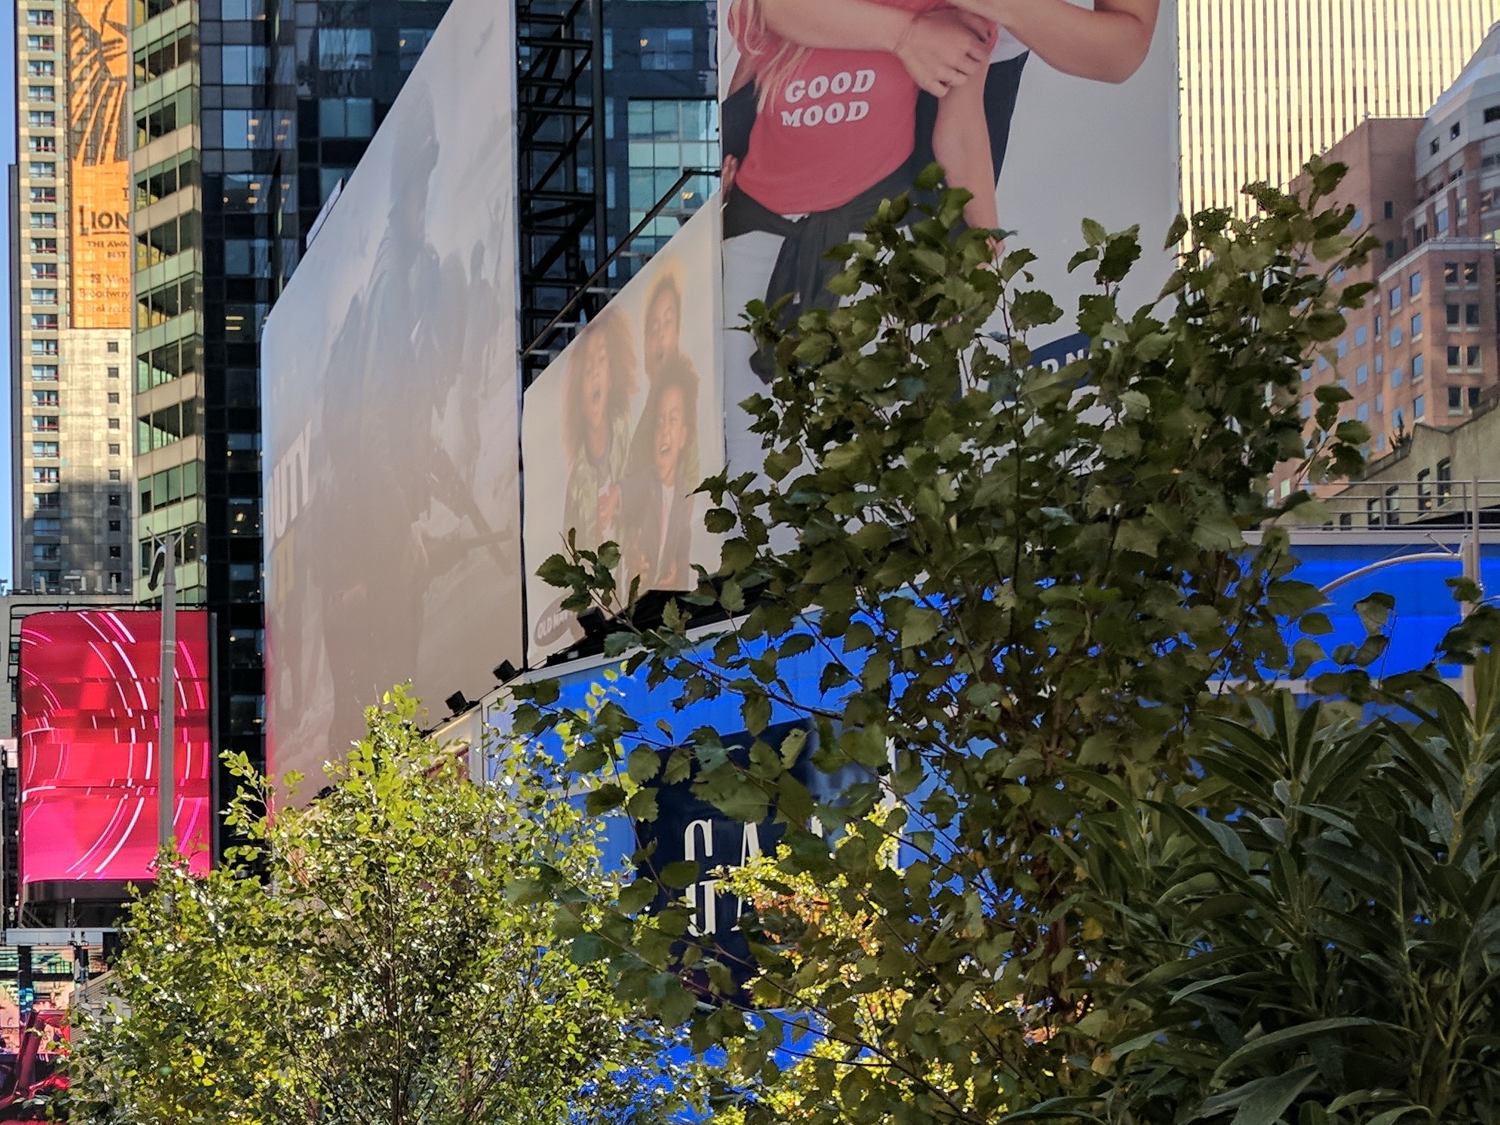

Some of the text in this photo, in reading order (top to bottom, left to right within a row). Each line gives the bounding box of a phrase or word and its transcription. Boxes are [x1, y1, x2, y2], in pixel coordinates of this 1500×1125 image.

[785, 69, 876, 103] GOOD
[781, 100, 869, 127] MOOD
[87, 240, 105, 248] THE
[537, 616, 552, 639] OLD
